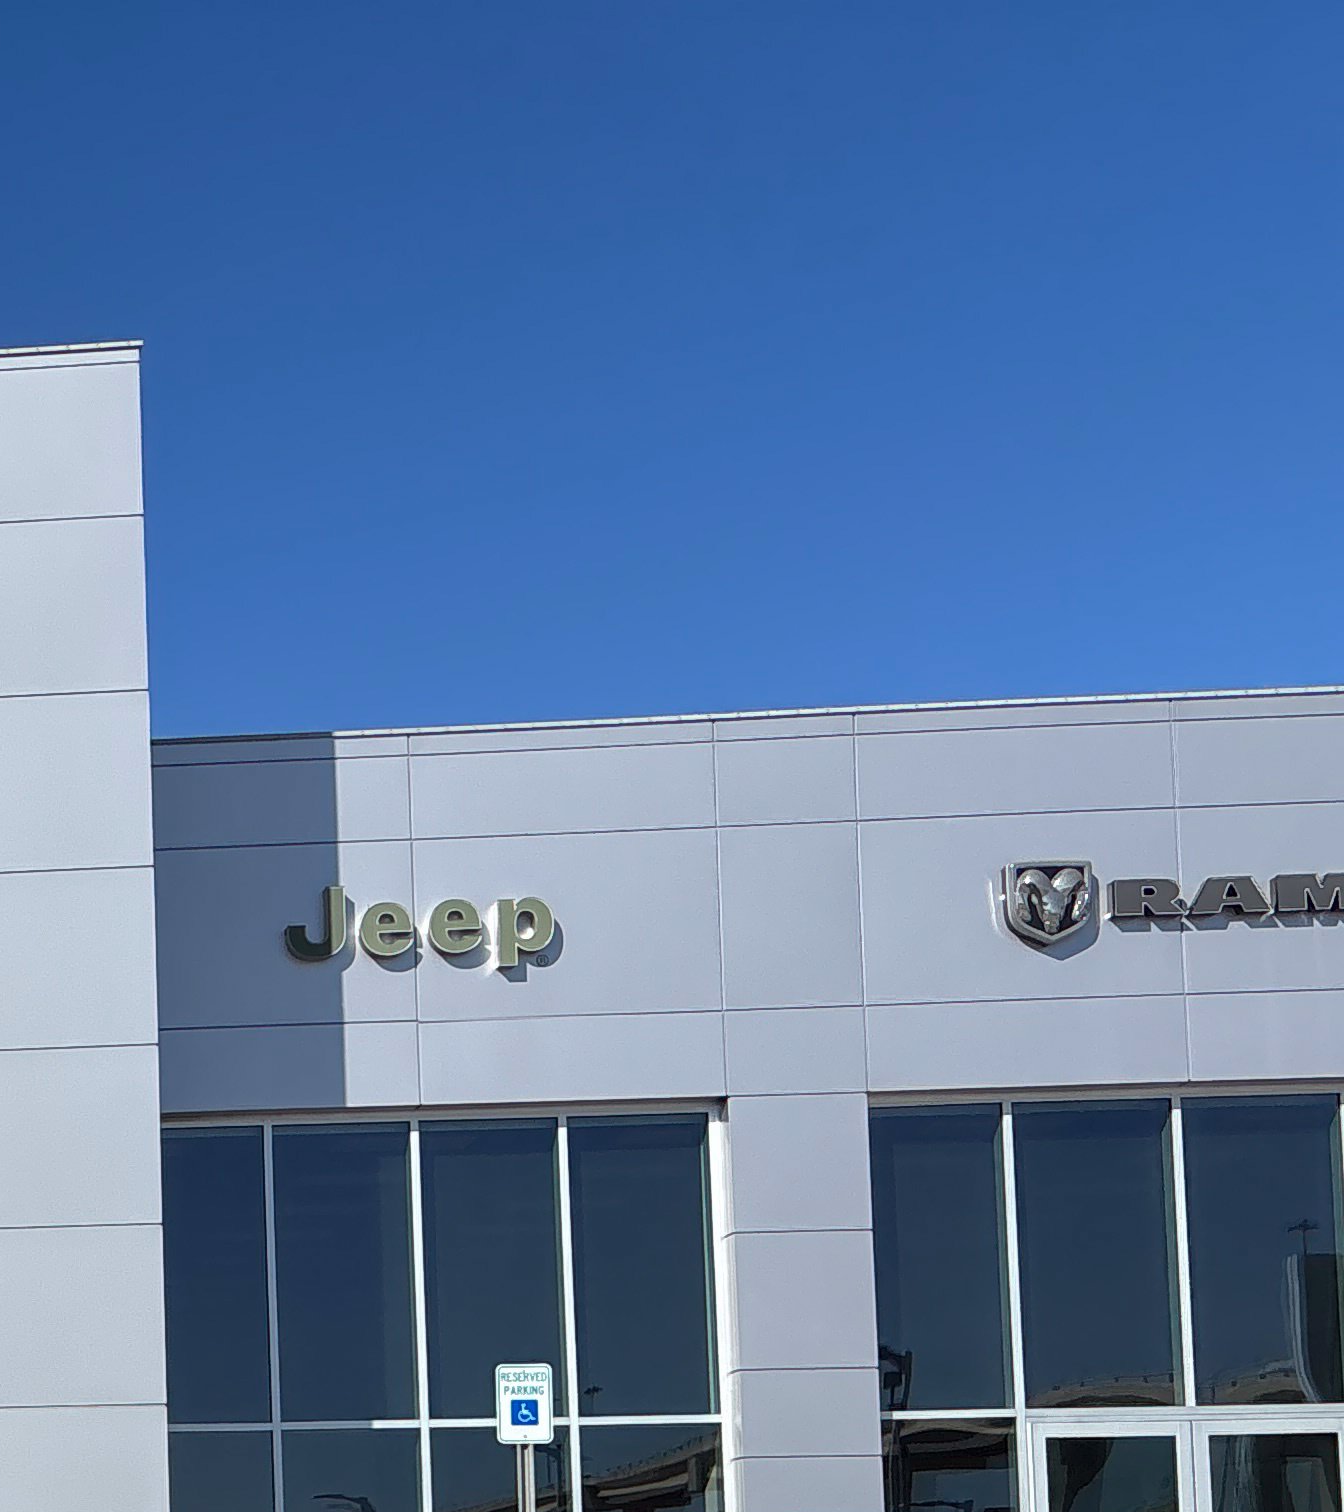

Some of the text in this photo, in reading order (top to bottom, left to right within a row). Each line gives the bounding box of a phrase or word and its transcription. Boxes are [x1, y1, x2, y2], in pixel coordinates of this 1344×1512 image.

[1109, 873, 1344, 918] RAM
[284, 886, 557, 967] Jeep
[500, 1371, 548, 1383] RESERVED
[503, 1385, 545, 1396] PARKING
